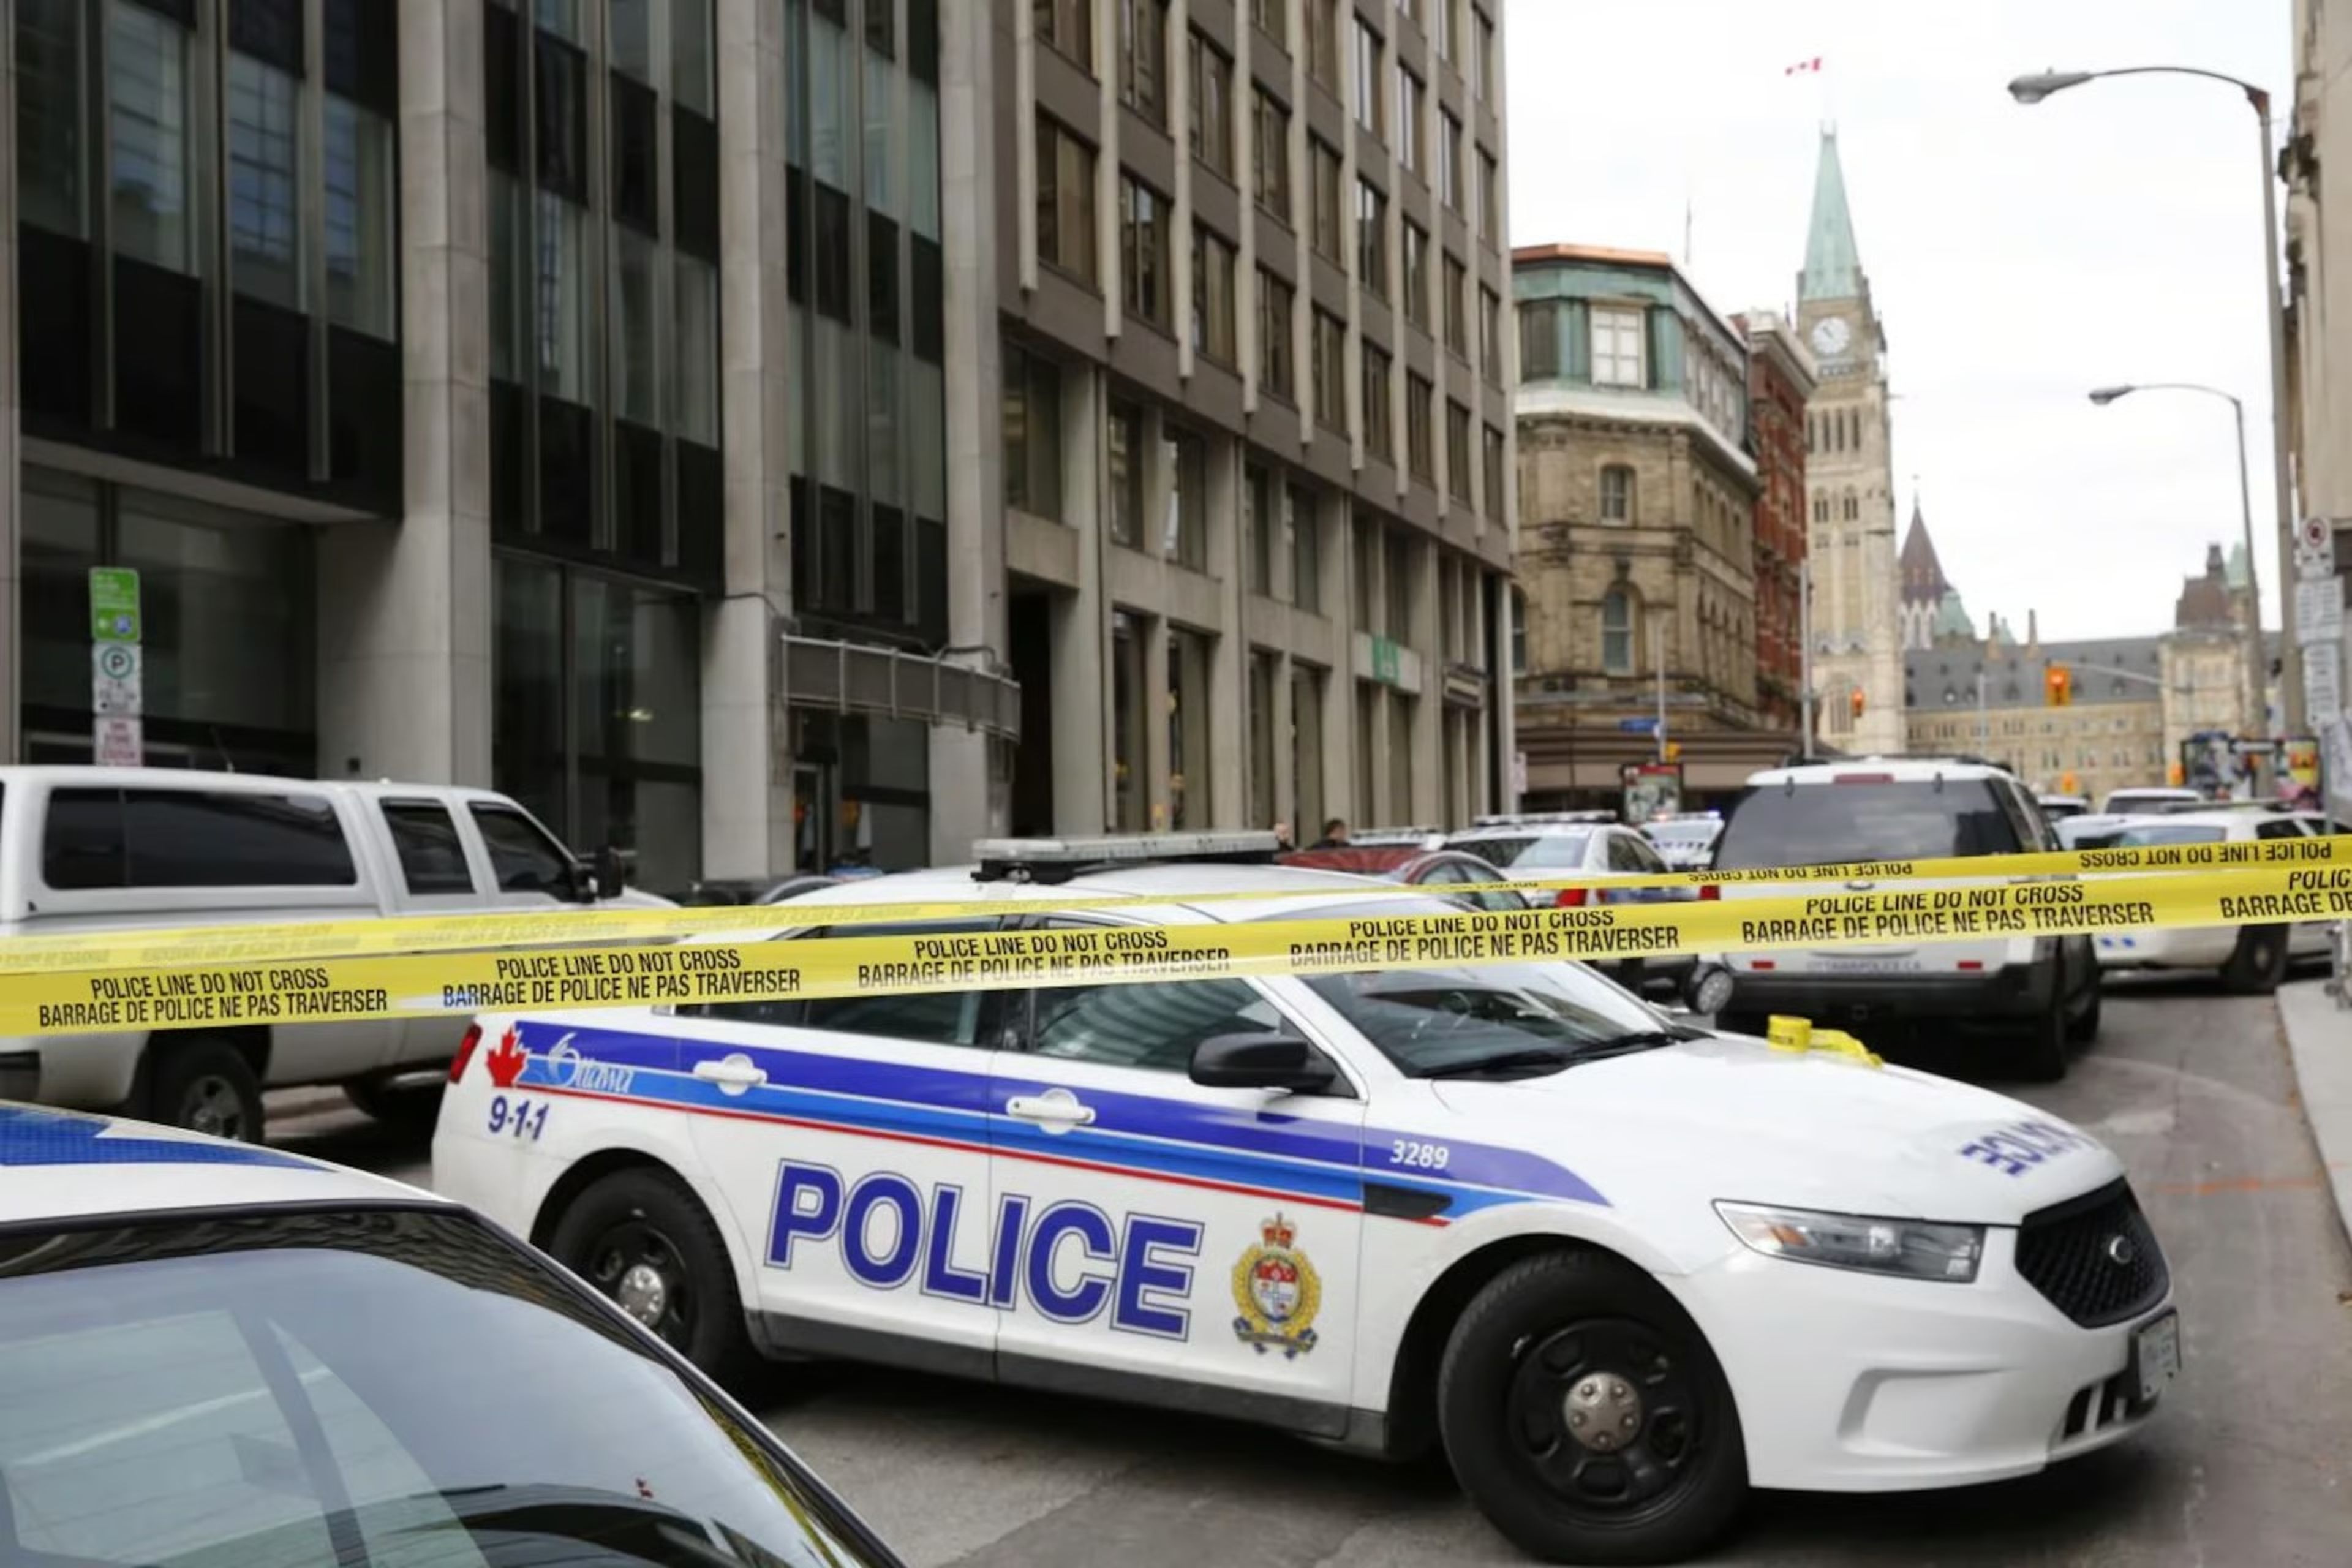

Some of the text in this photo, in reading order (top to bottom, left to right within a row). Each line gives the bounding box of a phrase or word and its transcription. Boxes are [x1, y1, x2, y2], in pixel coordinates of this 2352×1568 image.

[1853, 863, 1913, 875] POLICE
[2080, 843, 2331, 867] POLICE LINE DO NOT CROSS
[1806, 884, 2084, 915] POLICE LINE DO NOT CROSS
[2220, 891, 2352, 918] BARRAGE DE
[1350, 911, 1615, 938] POLICE LINE DO NOT CROSS
[1743, 902, 2154, 943] BARRAGE DE POLICE NE PAS TRAVERSER
[914, 931, 1167, 959] POLICE LINE DO NOT CROSS
[1291, 926, 1679, 967] BARRAGE DE POLICE NE PAS TRAVERSER
[497, 949, 741, 979] POLICE LINE DO NOT CROSS
[858, 949, 1230, 987] BARRAGE DE POLICE NE PAS TRAVERSER
[91, 968, 329, 1000] POLICE LINE DO NOT CROSS
[443, 969, 801, 1008] BARRAGE DE POLICE NE PAS TRAVERSER
[40, 989, 388, 1027] BARRAGE DE POLICE NE PAS TRAVERSER
[548, 1032, 635, 1093] Ottawa
[1389, 1139, 1449, 1169] 3289
[764, 1158, 1205, 1343] POLICE
